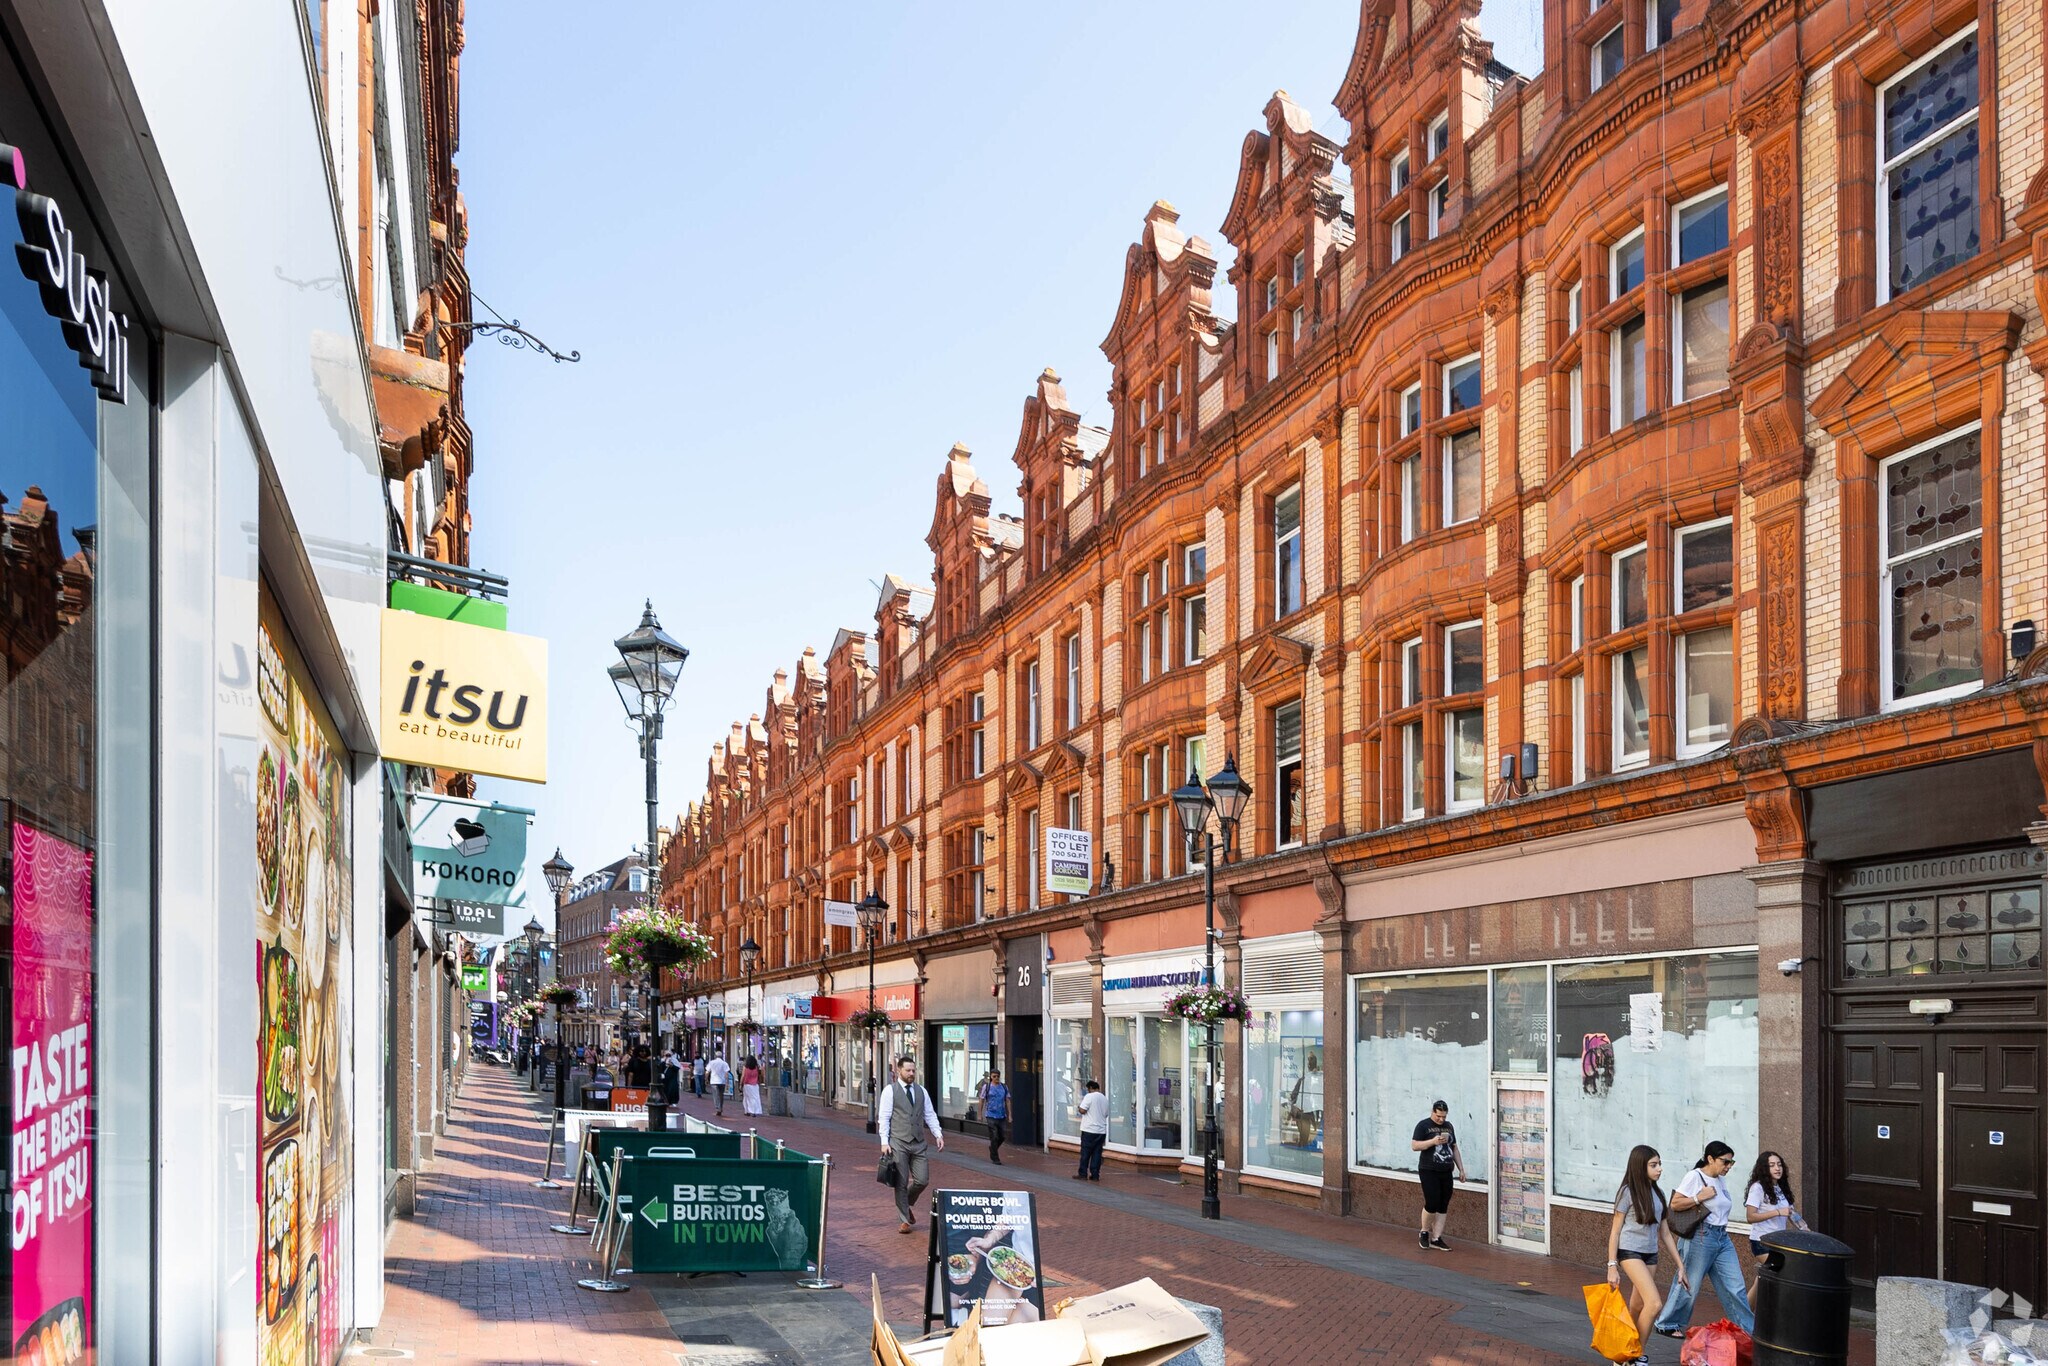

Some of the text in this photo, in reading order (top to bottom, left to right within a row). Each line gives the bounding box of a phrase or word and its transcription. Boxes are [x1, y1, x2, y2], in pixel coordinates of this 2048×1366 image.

[45, 196, 129, 406] sushi
[399, 660, 528, 732] itsu
[399, 722, 522, 750] eat beautiful
[1051, 832, 1089, 843] OFFICES
[1052, 841, 1089, 852] TO LET
[422, 860, 516, 888] KOKORO
[1018, 965, 1030, 986] 26
[13, 1023, 87, 1124] TASTE
[13, 1095, 87, 1182] THE BEST
[12, 1146, 88, 1251] OF ITSU
[673, 1184, 765, 1202] BEST
[951, 1196, 1022, 1207] POWER BOWL
[673, 1204, 765, 1221] BURRITOS
[945, 1213, 1030, 1225] POWER BURRITO
[674, 1223, 764, 1243] IN TOWN
